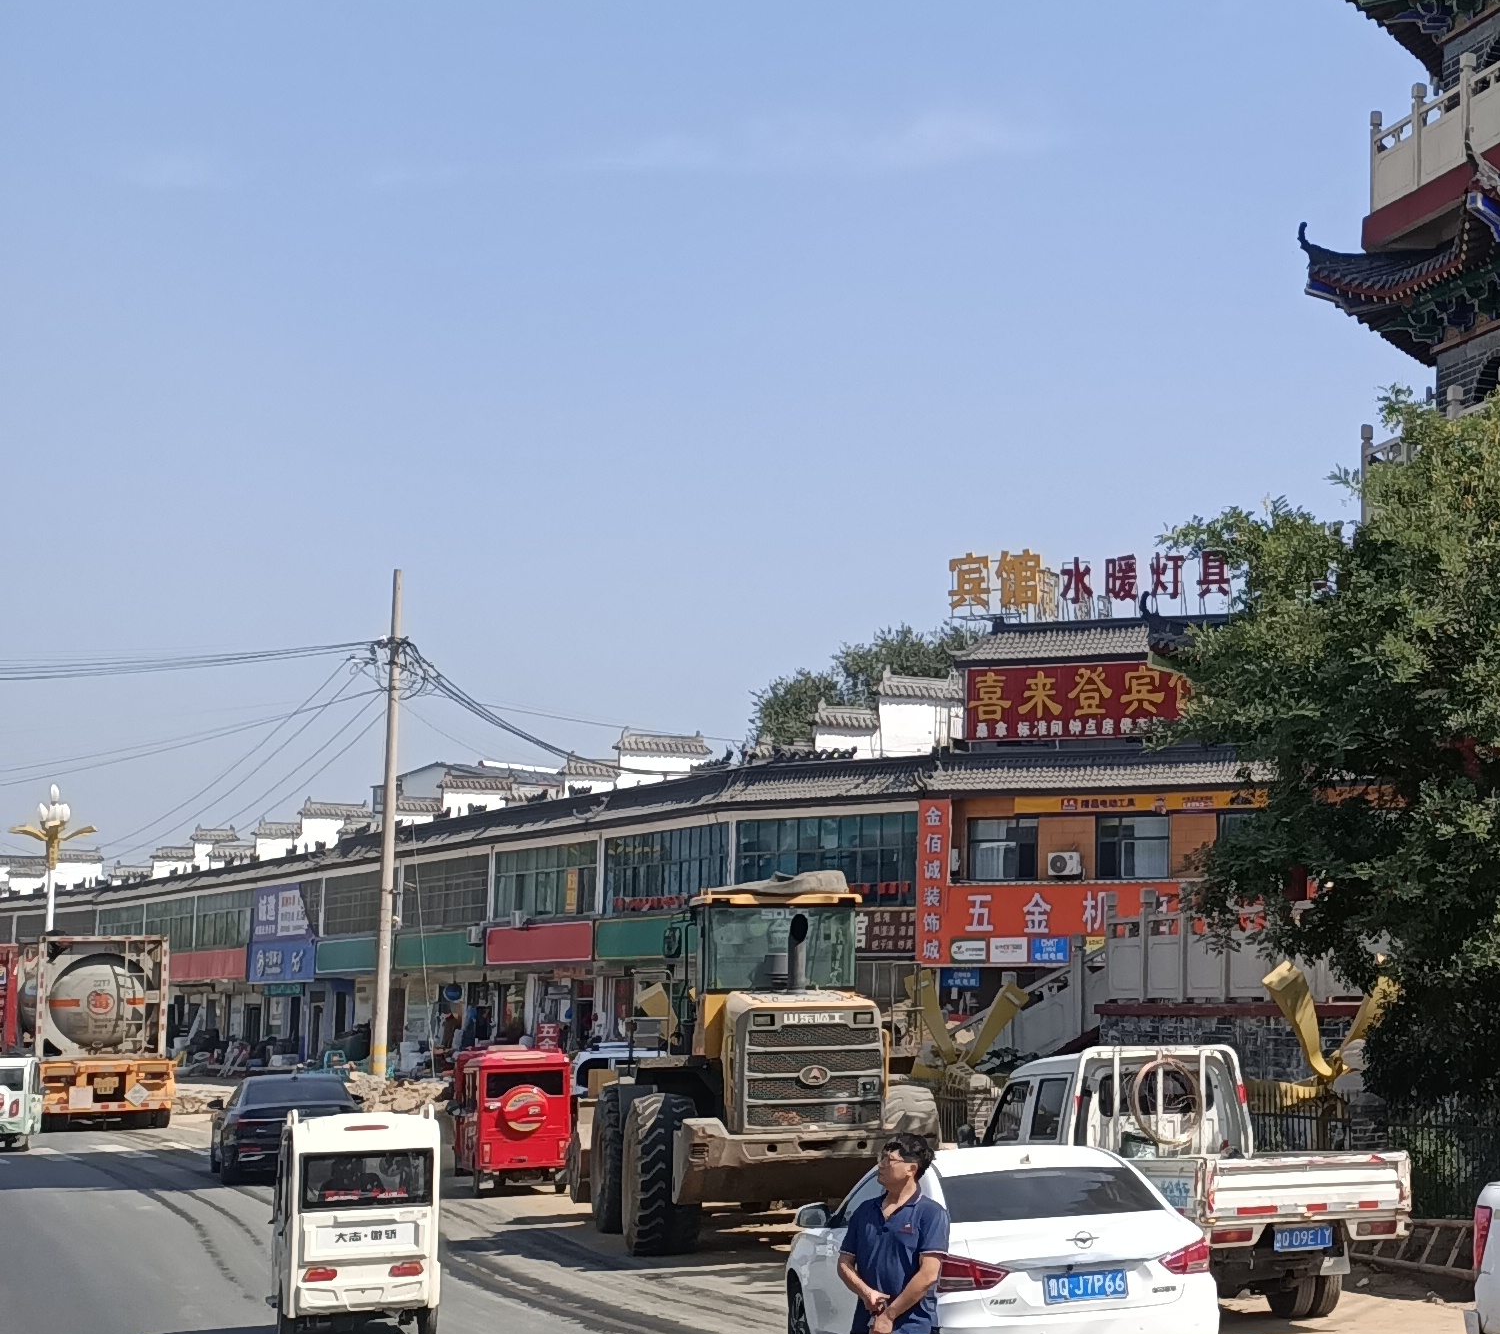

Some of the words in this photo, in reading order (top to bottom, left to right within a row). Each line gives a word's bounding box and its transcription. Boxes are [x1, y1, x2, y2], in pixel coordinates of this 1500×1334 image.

[948, 548, 1041, 610] 宾馆
[1060, 550, 1231, 605] 水暖灯具
[922, 806, 942, 959] 金佰诚装饰城
